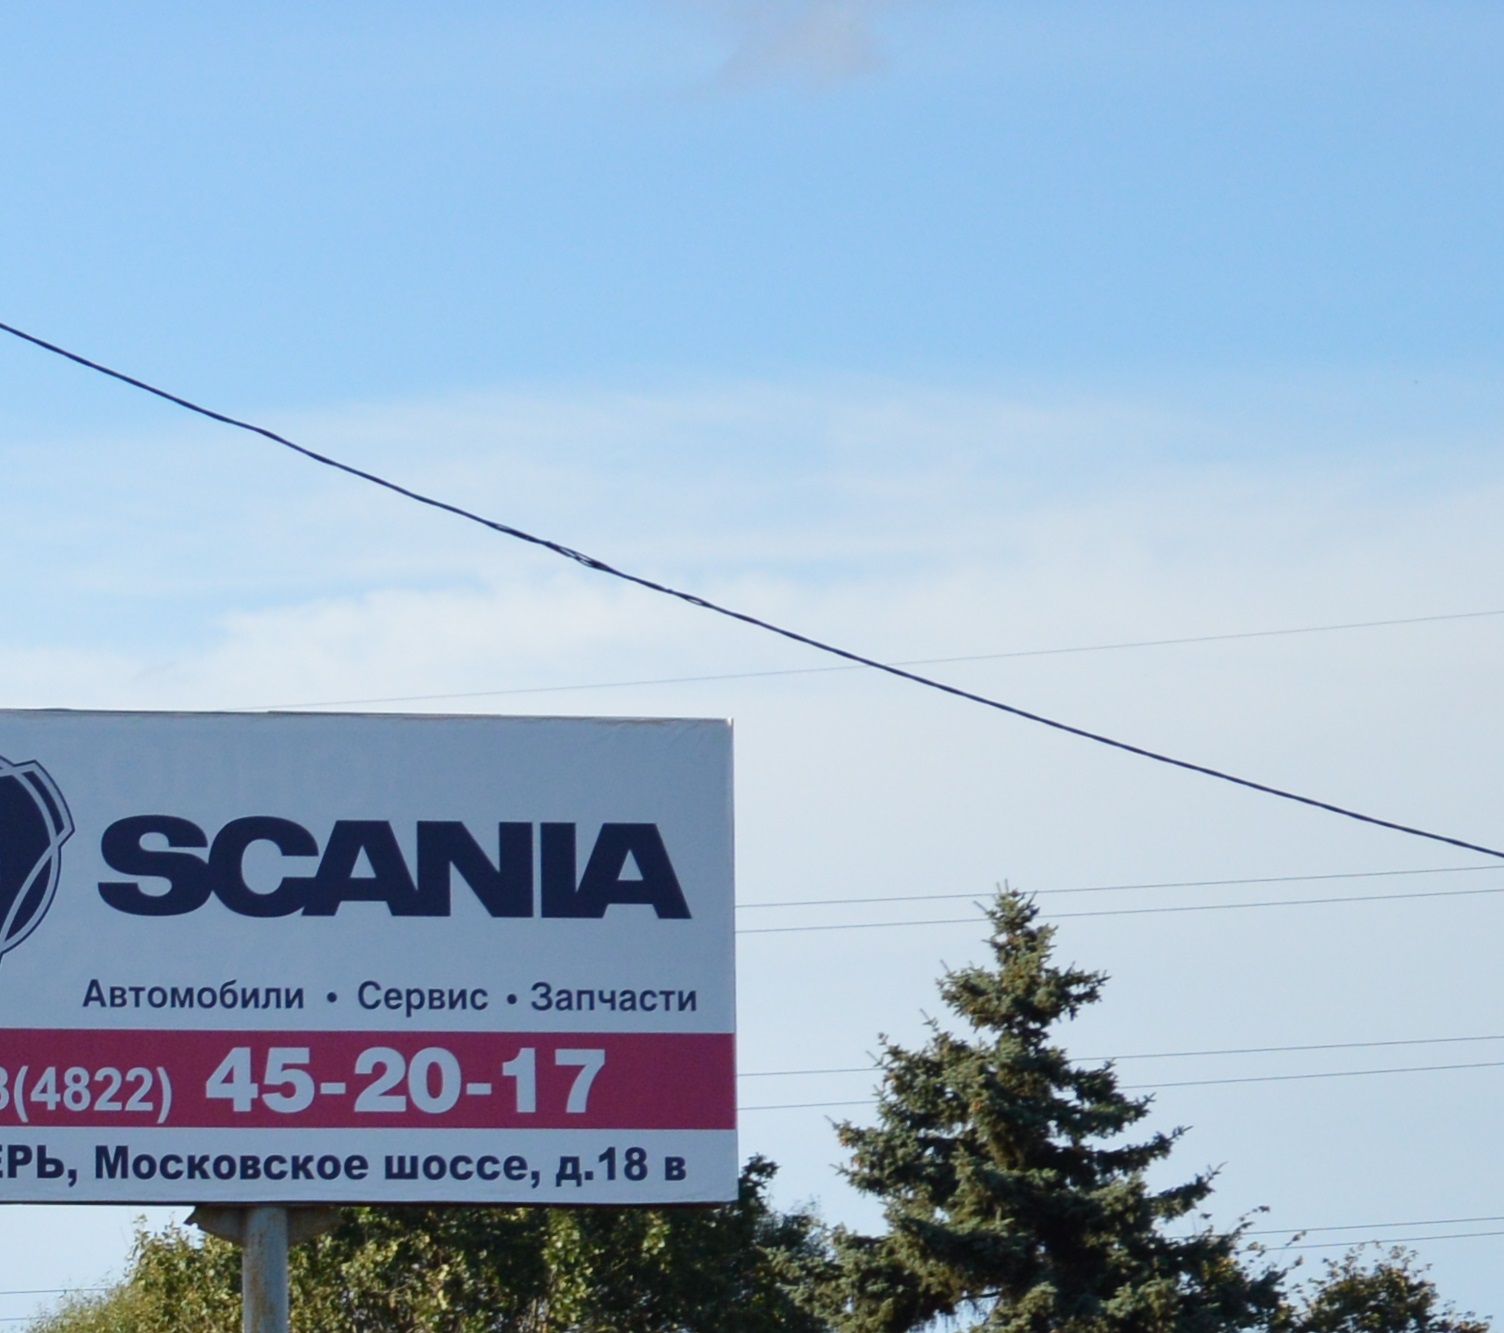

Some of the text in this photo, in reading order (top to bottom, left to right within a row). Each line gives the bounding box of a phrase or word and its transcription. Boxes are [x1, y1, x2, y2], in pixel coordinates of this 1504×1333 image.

[98, 815, 691, 919] SCANIA
[83, 979, 697, 1017] Автомобили Сервис Запчасти
[206, 1047, 606, 1114] 45-20-17
[96, 1146, 369, 1180] Московское
[385, 1155, 540, 1188] шоссе,
[556, 1147, 648, 1188] д.18
[665, 1156, 687, 1181] в
